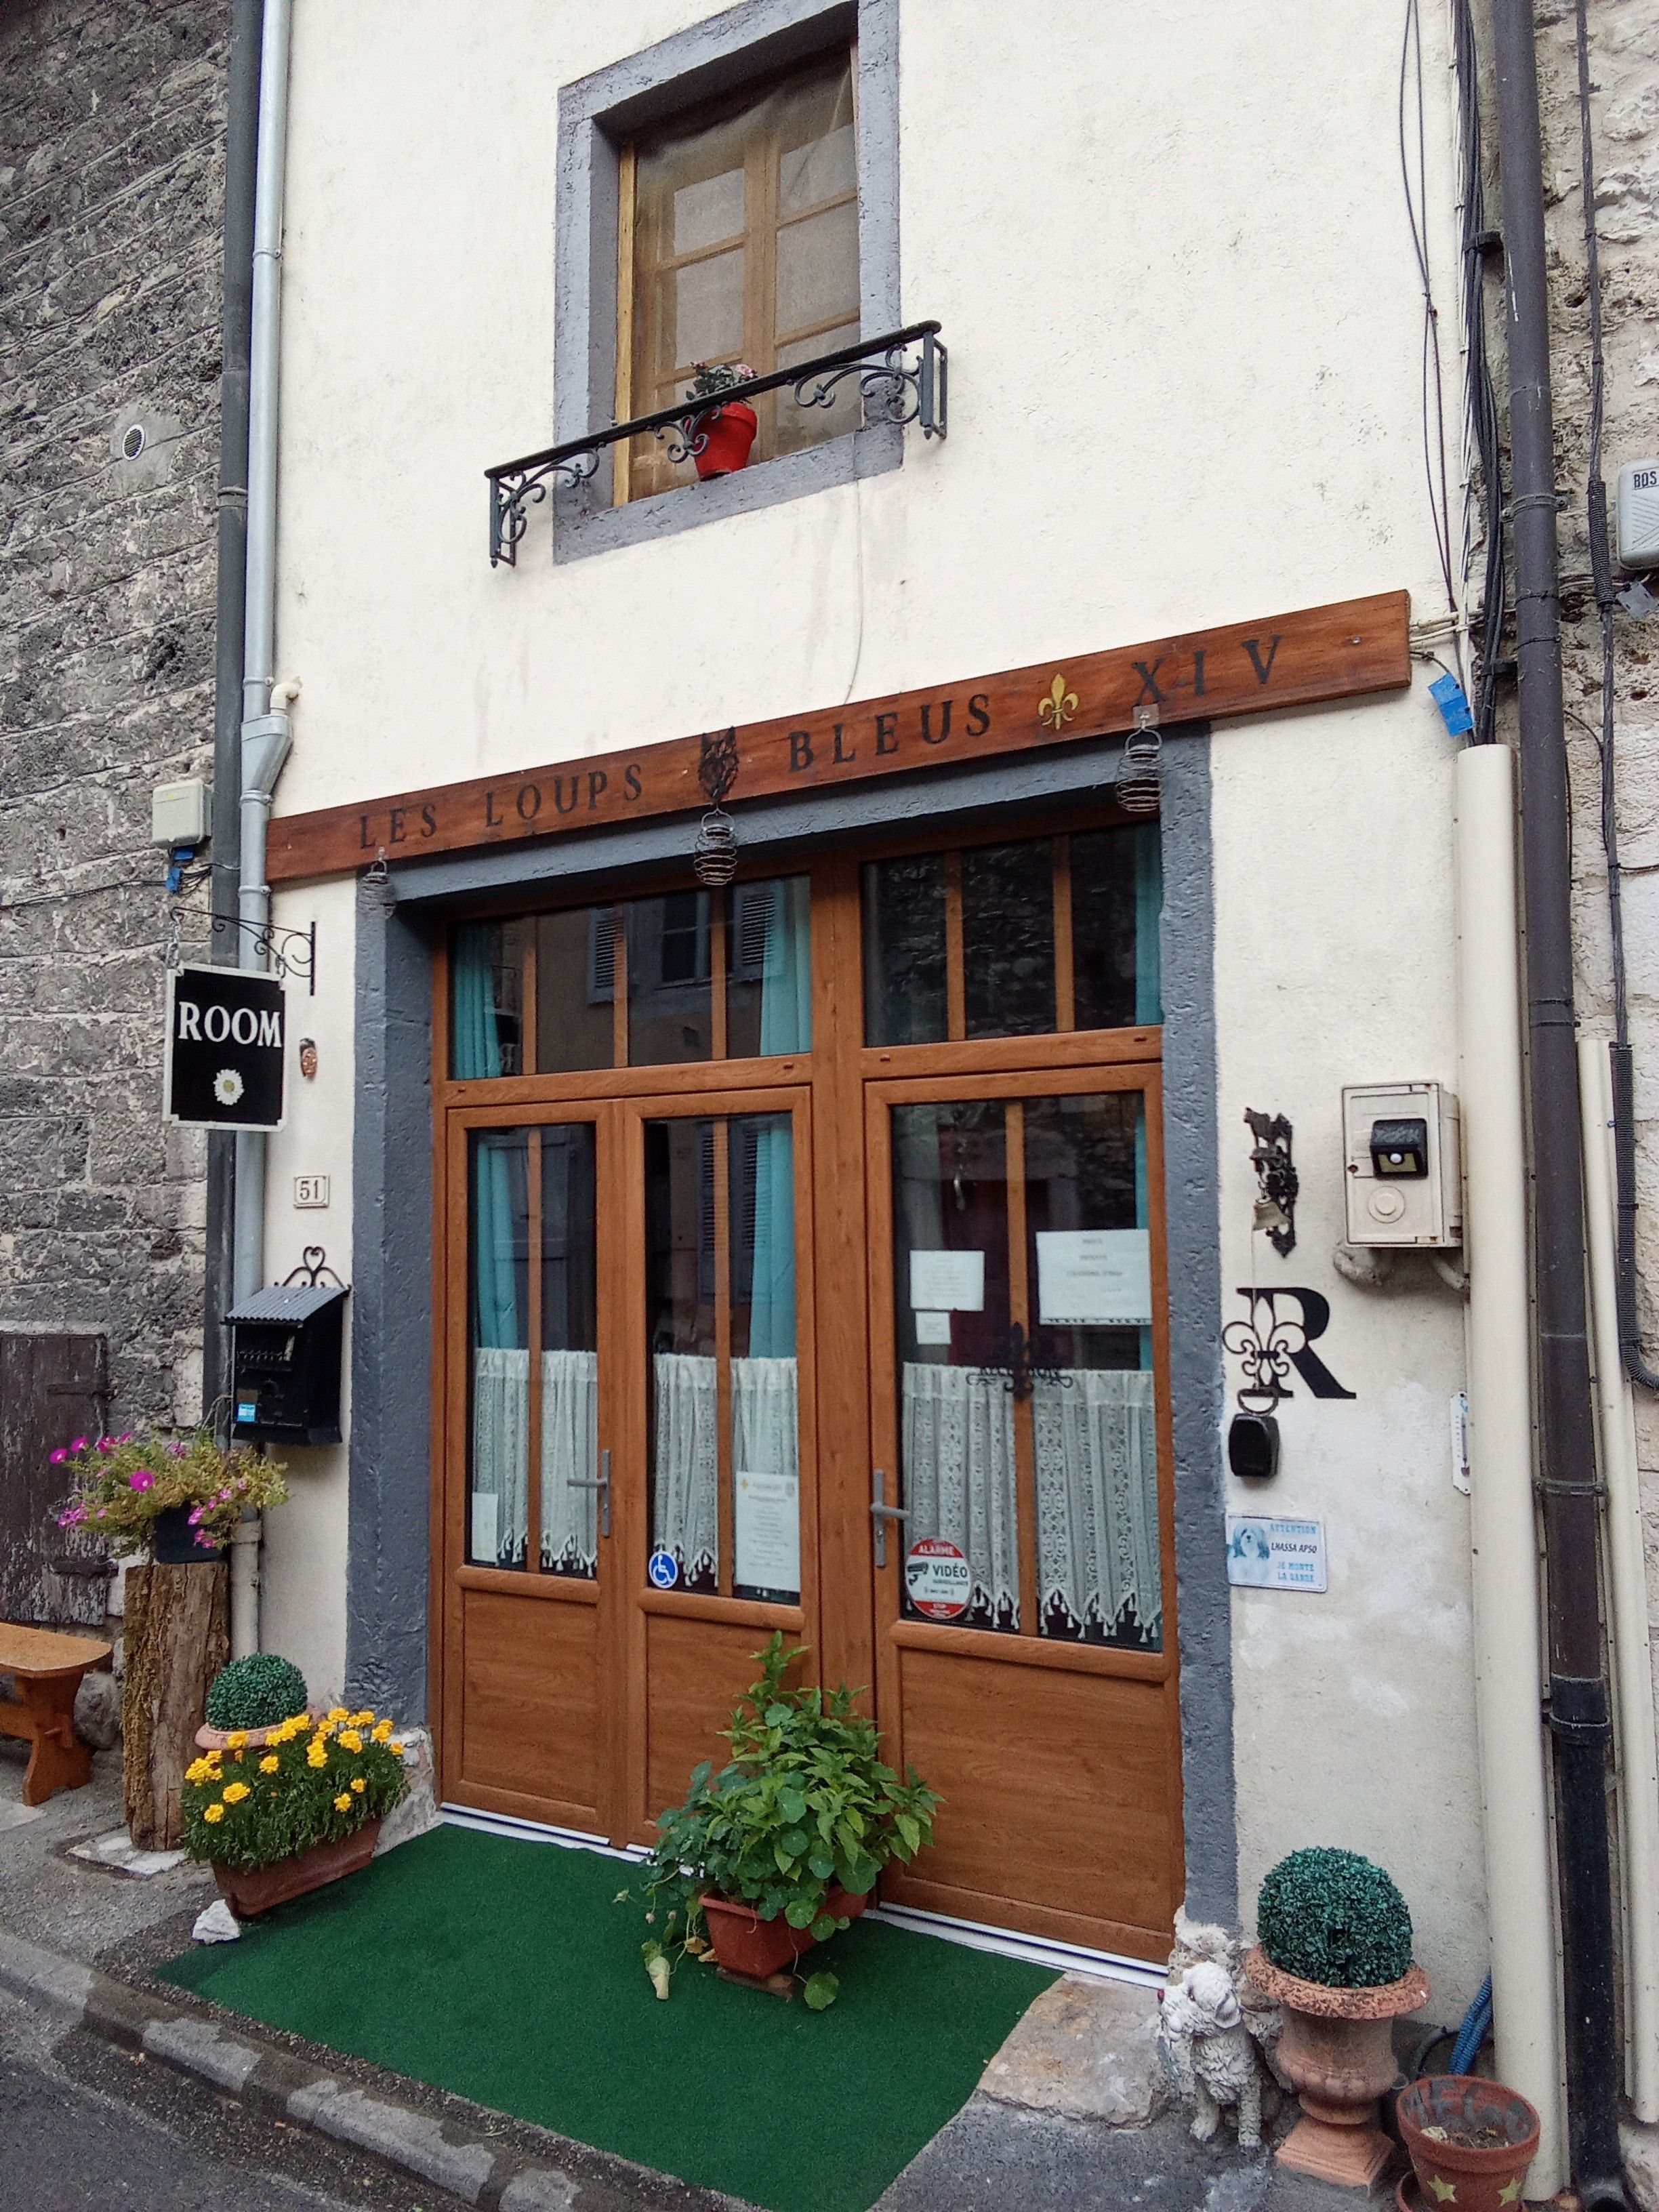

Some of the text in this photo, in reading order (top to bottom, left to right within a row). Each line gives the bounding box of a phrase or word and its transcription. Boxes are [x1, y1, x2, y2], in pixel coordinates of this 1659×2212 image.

[360, 634, 1283, 849] LES LOUPS BLEUS XIV
[178, 1001, 282, 1048] ROOM
[299, 1180, 319, 1201] 51
[933, 1562, 968, 1578] VIDÉO
